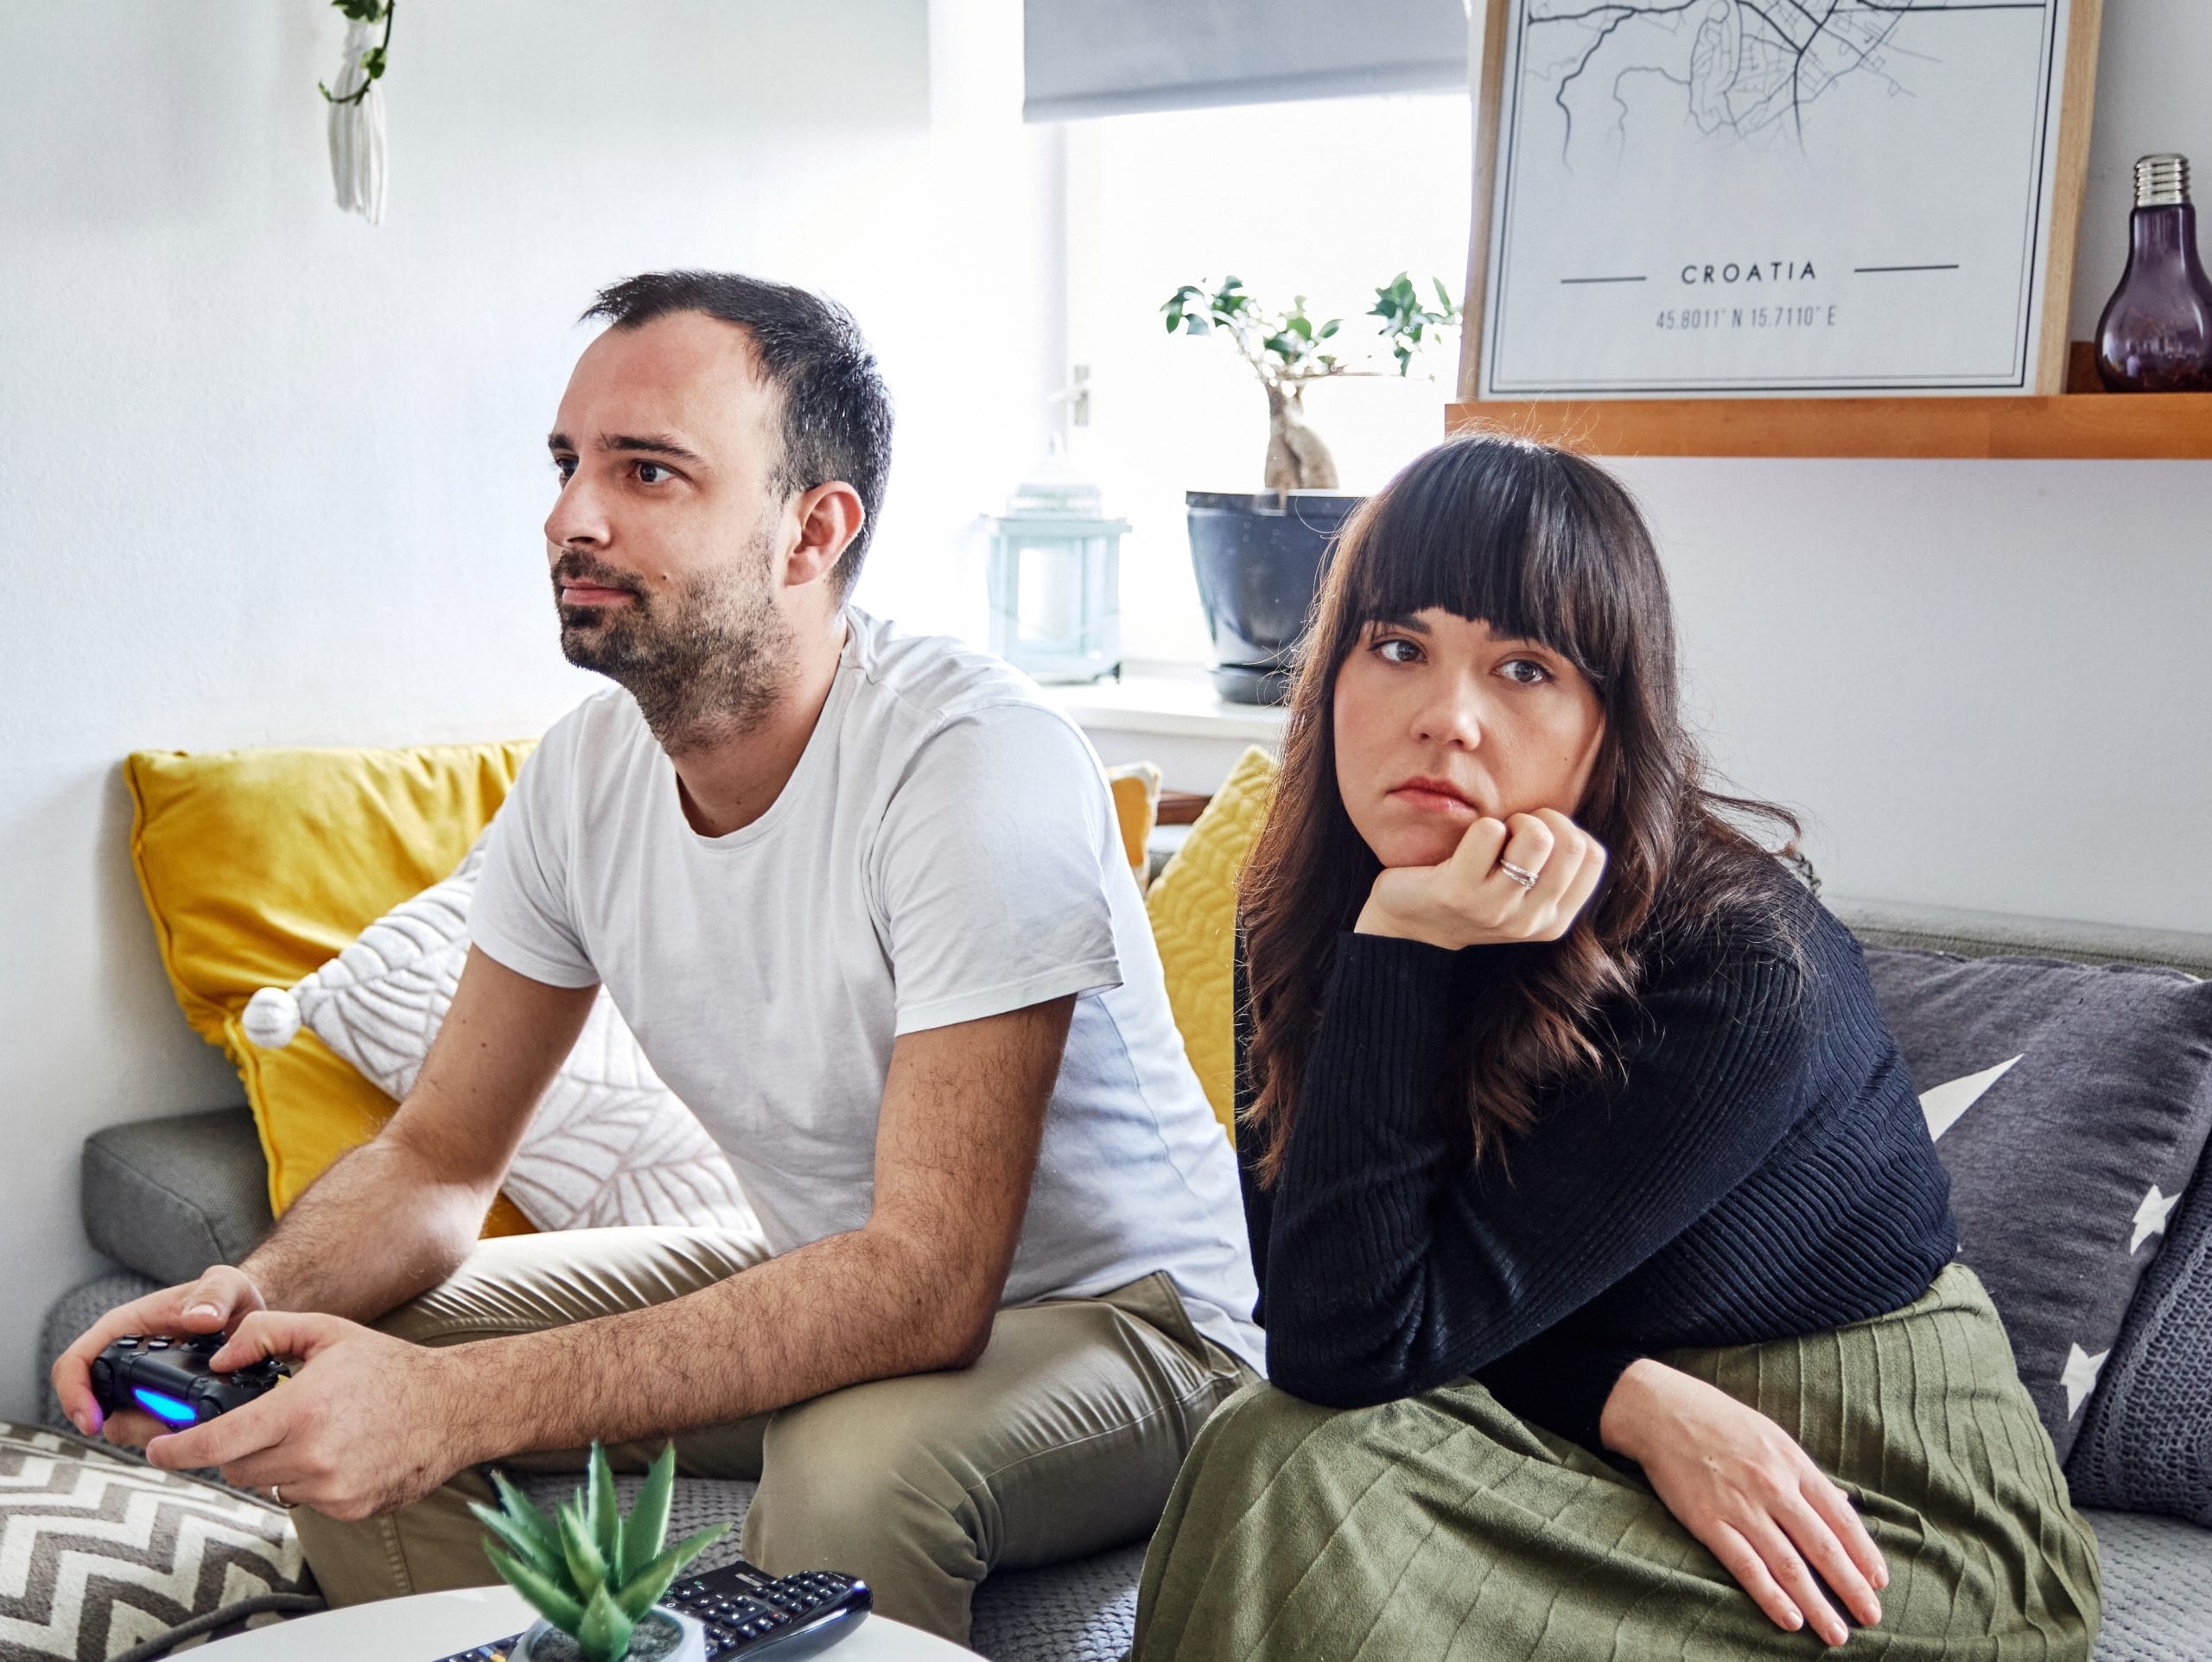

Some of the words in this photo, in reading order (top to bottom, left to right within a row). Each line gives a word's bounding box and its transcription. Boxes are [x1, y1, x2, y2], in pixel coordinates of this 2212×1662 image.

[1681, 260, 1816, 285] CROATIA
[1731, 308, 1742, 328] N
[1827, 304, 1837, 327] E
